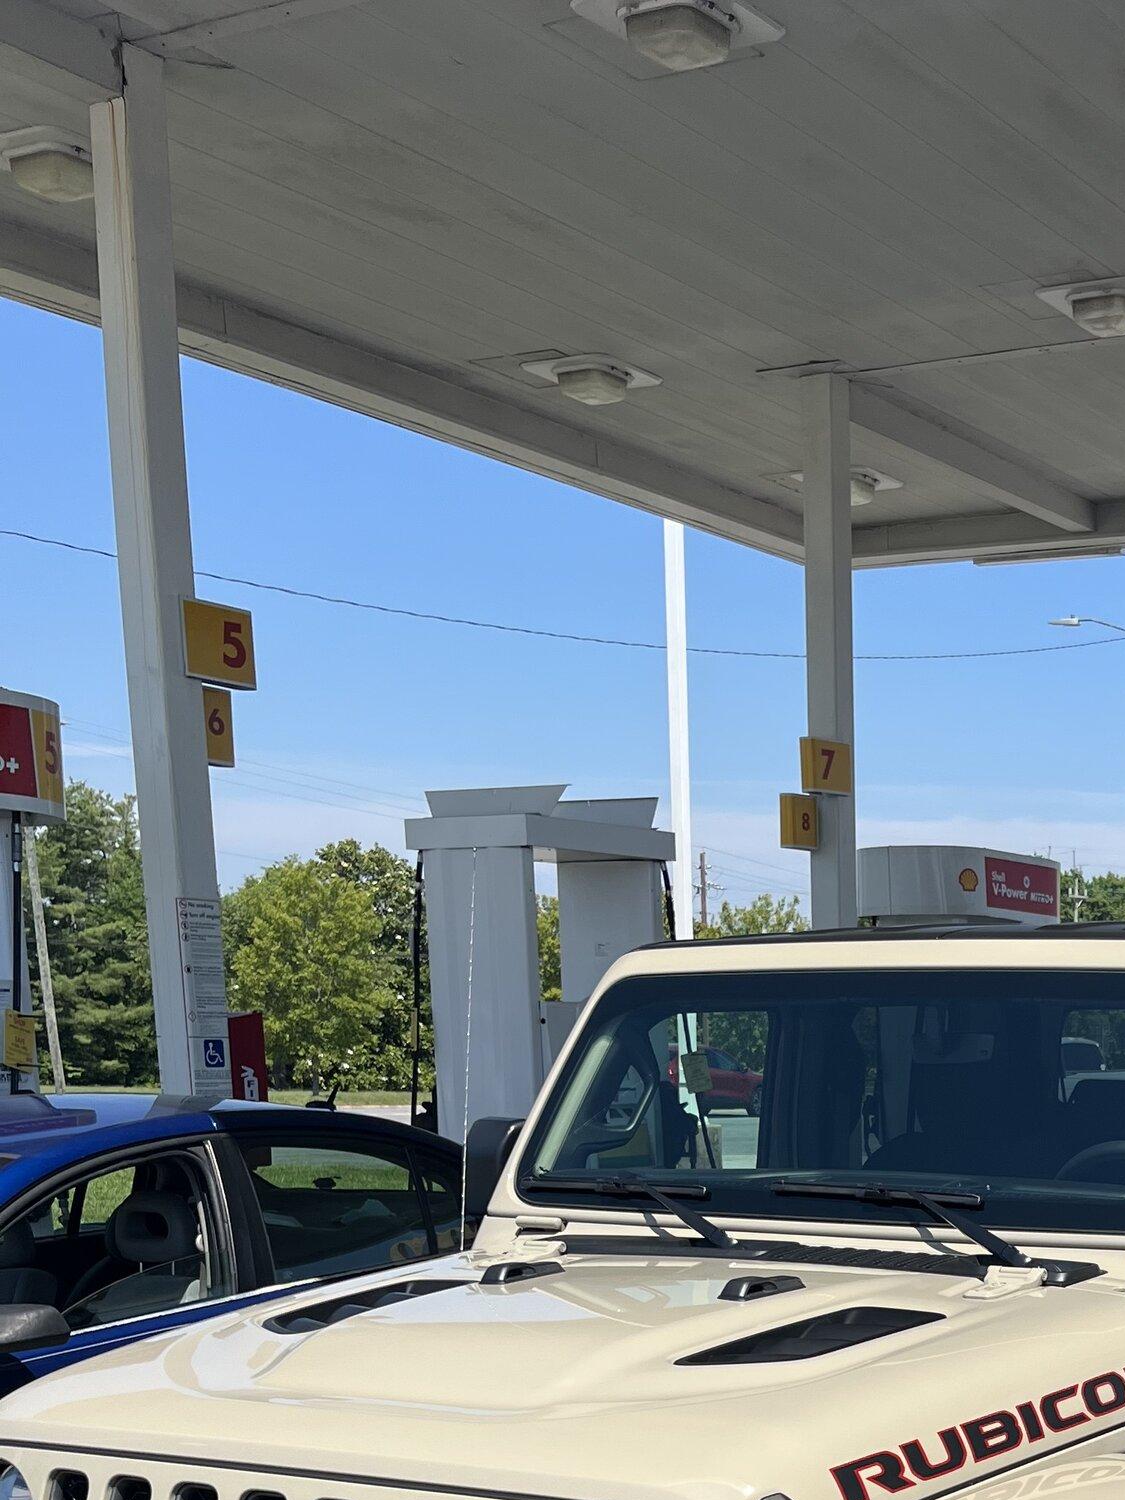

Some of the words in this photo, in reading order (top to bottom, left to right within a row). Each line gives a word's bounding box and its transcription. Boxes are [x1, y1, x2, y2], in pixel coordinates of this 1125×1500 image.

[222, 620, 247, 669] 5
[207, 708, 225, 737] 6
[44, 731, 60, 775] 5
[821, 749, 835, 780] 7
[801, 812, 810, 832] 8
[991, 870, 1006, 883] Shell
[992, 882, 1028, 901] V-Power
